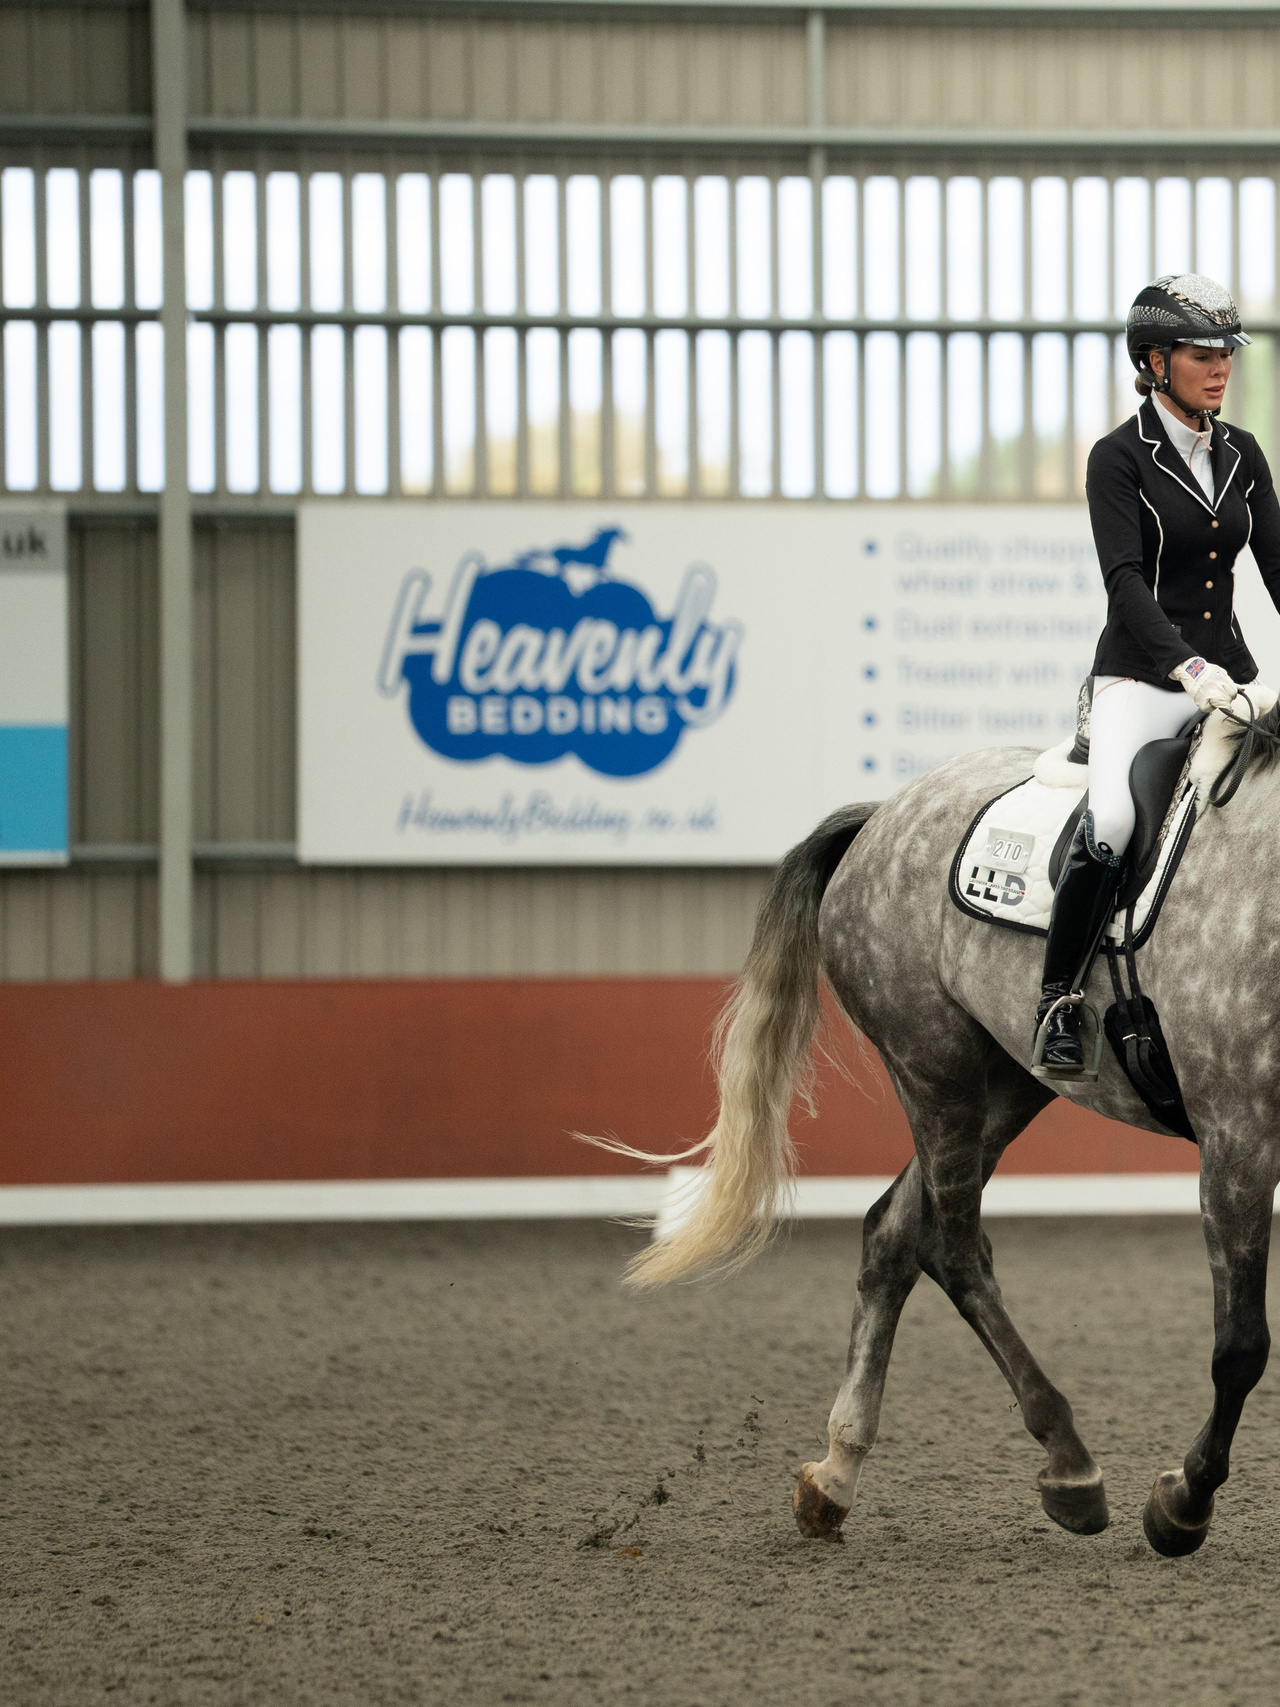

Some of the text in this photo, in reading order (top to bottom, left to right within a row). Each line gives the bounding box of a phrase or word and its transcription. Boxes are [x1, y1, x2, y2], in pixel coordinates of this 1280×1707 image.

[378, 552, 743, 729] Heavenly
[446, 696, 669, 735] BEDDING
[992, 840, 1022, 861] 210
[965, 866, 1026, 906] LLD
